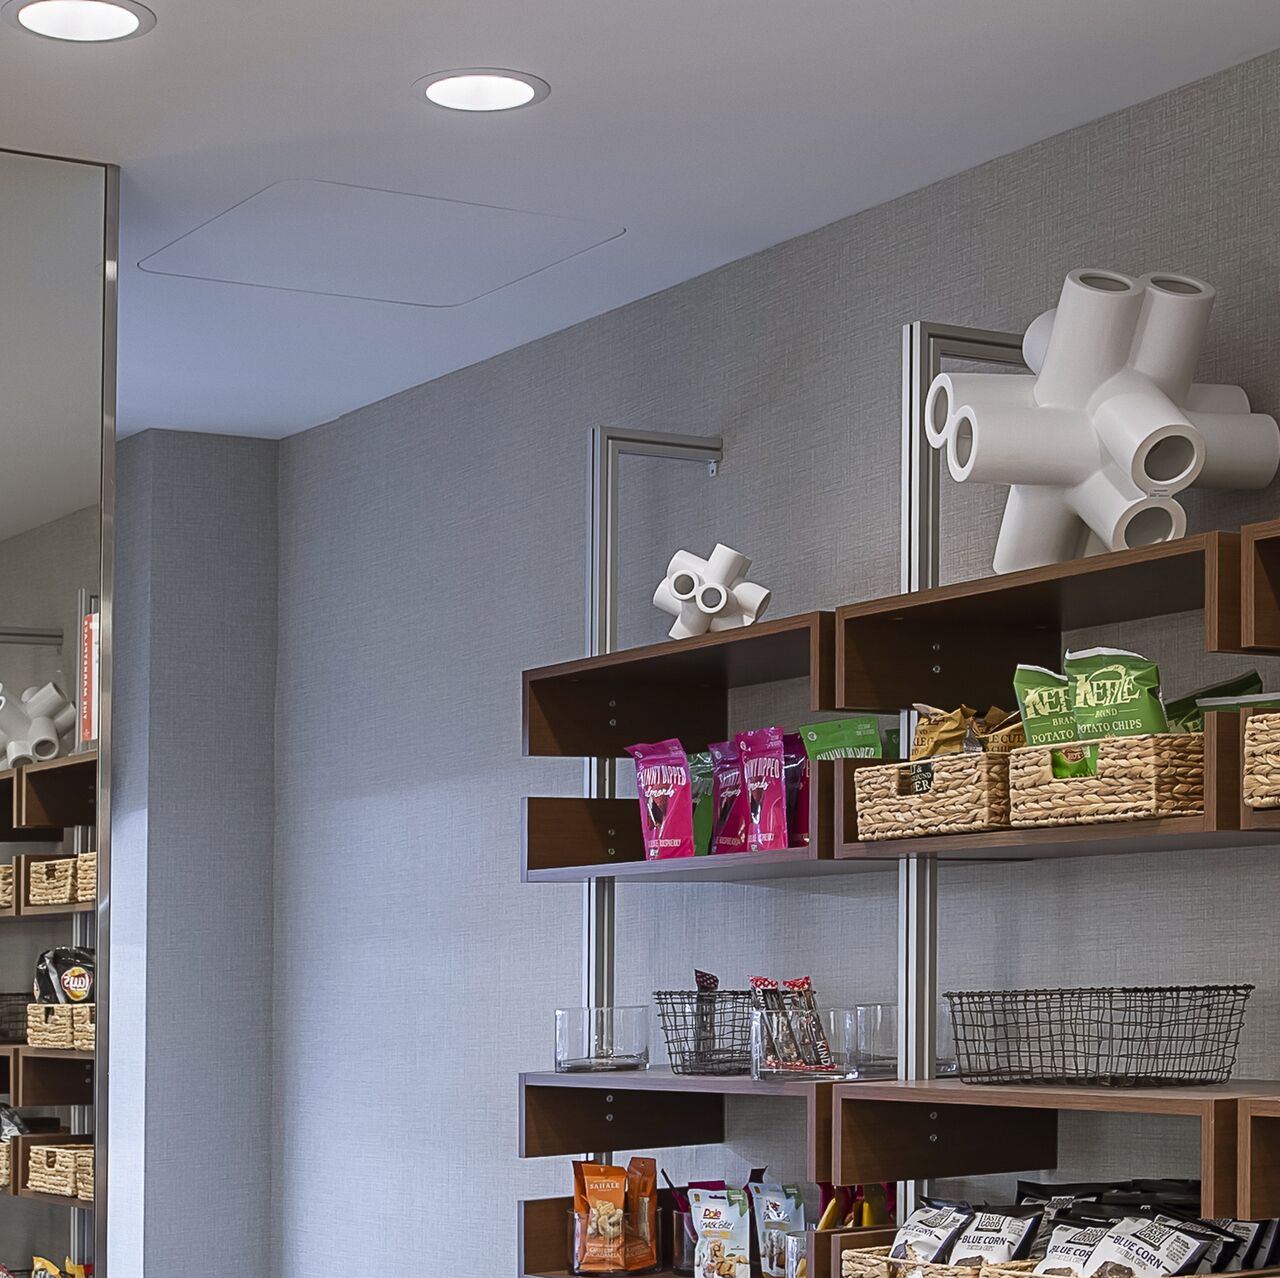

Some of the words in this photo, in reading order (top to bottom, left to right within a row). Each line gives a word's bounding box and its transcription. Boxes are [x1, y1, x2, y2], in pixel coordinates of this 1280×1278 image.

[1113, 719, 1142, 731] CHIPS
[1032, 730, 1074, 745] POTATO
[816, 1041, 830, 1065] KIND
[590, 1181, 620, 1190] SAHALE
[703, 1207, 721, 1219] Dole
[982, 1214, 1002, 1222] TASTE
[984, 1236, 1007, 1245] CORN
[1113, 1235, 1137, 1251] BLUE
[1135, 1247, 1164, 1269] CORN
